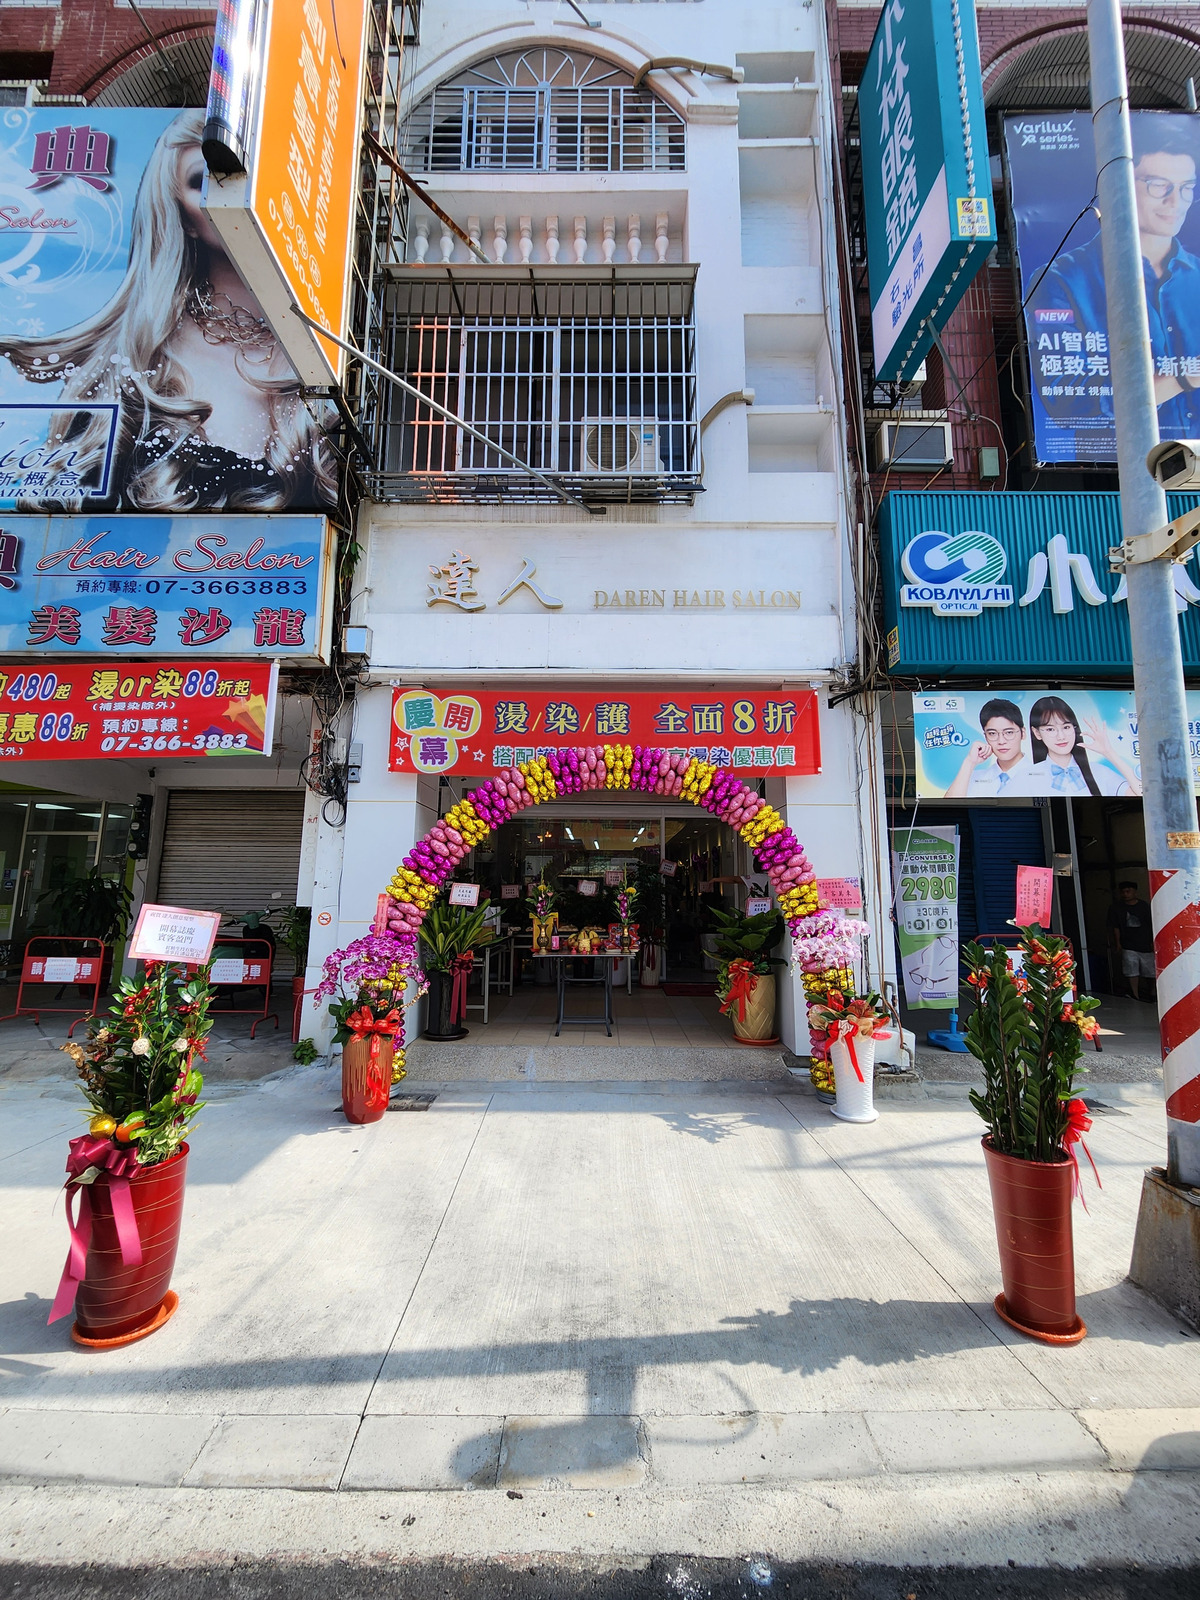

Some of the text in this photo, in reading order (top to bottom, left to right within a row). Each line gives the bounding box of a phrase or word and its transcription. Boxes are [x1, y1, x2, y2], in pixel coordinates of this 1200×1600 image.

[1013, 119, 1074, 135] Varilux
[1039, 133, 1074, 143] series
[24, 124, 111, 191] 典
[320, 126, 335, 188] HAIR
[313, 174, 330, 254] SALON
[1039, 312, 1070, 321] NEW
[1037, 331, 1109, 353] AI智能
[1040, 354, 1200, 377] 極致完漸進
[28, 488, 88, 498] SALON
[36, 530, 161, 571] Hair
[172, 532, 315, 573] Salon
[426, 549, 564, 613] 達人
[593, 589, 803, 609] DAREN HAIR SALON
[907, 587, 1012, 601] KOBAYASHI
[940, 602, 981, 611] OPTICAL
[26, 605, 308, 647] 美髮沙龍
[654, 699, 798, 736] 全面8折
[101, 733, 249, 752] 07-366-3883
[909, 854, 948, 862] CONVERSE
[900, 875, 957, 902] 2980
